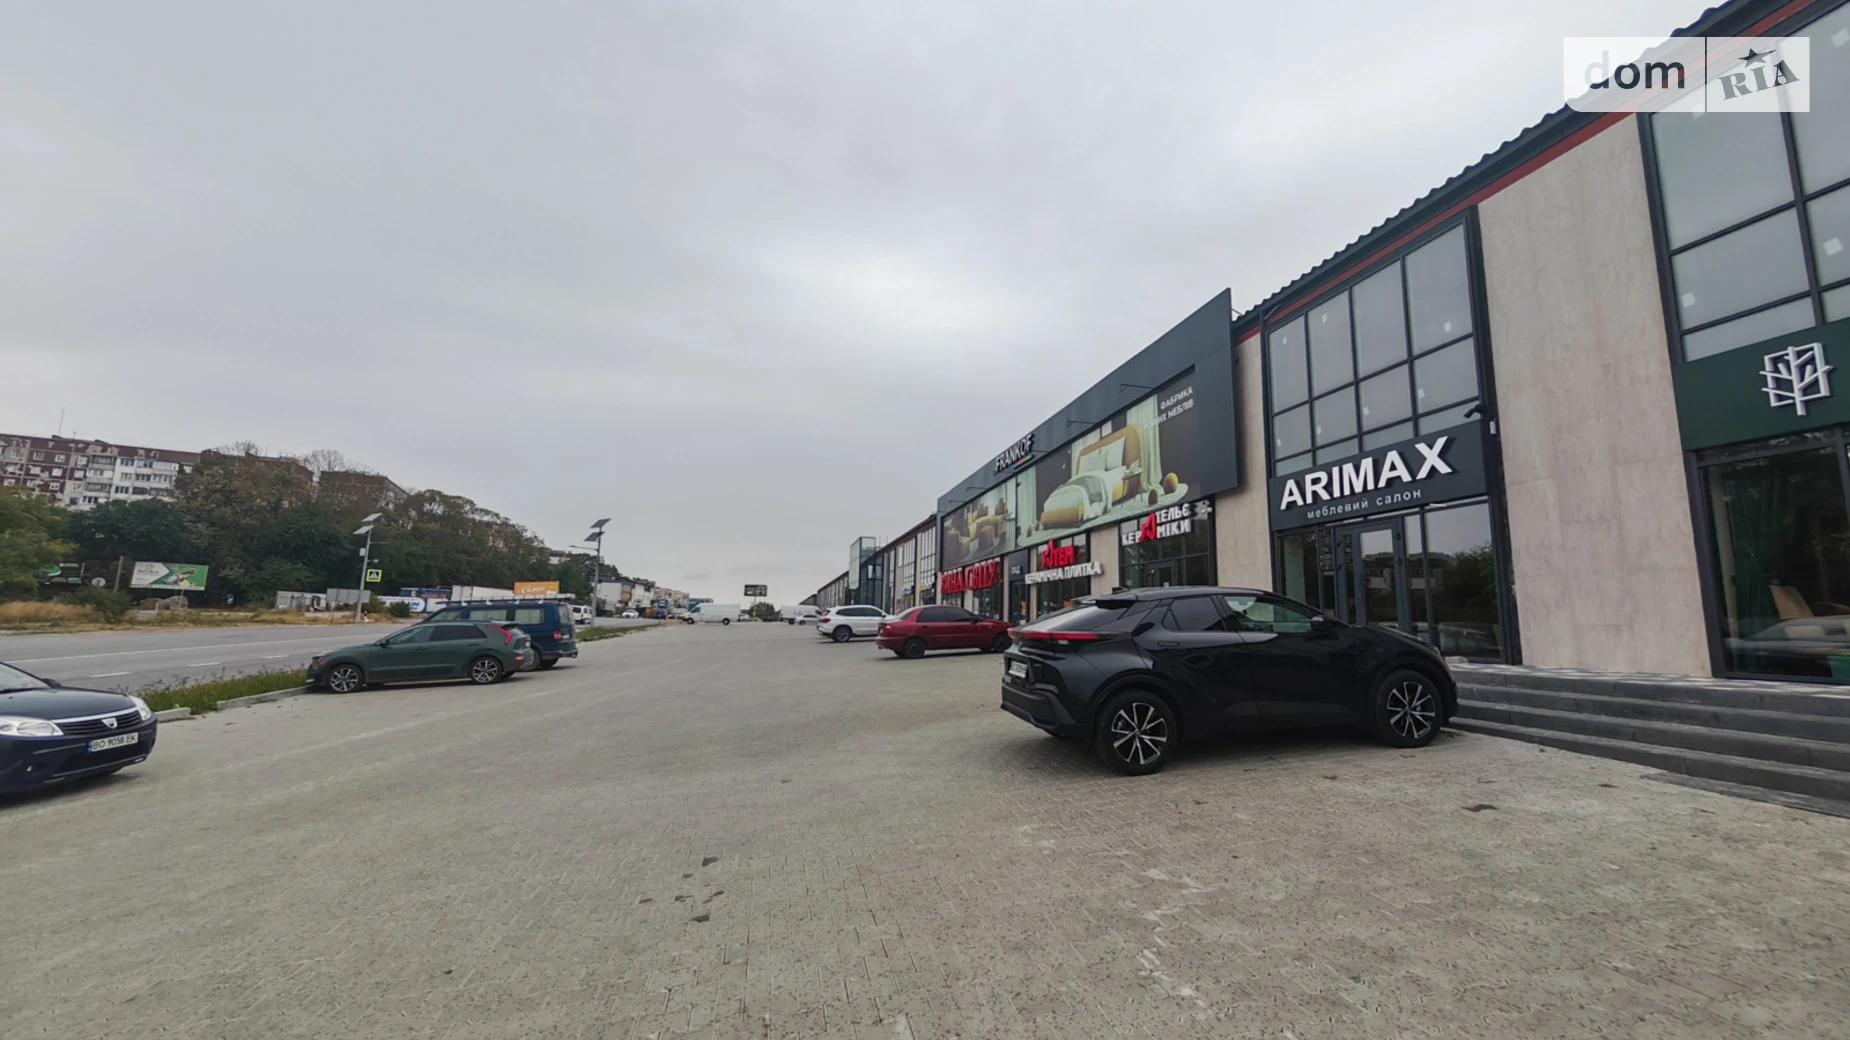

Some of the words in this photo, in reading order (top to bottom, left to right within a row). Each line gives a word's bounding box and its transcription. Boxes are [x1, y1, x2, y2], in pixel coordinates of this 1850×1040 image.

[1160, 386, 1193, 410] ФАБРИКА
[1168, 398, 1194, 418] МЕБЛІВ
[995, 434, 1032, 472] FRANKOF
[1280, 436, 1453, 510] ARIMAX
[1307, 498, 1369, 519] меблевий
[1376, 489, 1422, 506] салон
[1025, 567, 1065, 585] КЕРАМІЧНА
[1064, 561, 1102, 579] ПЛИТКА
